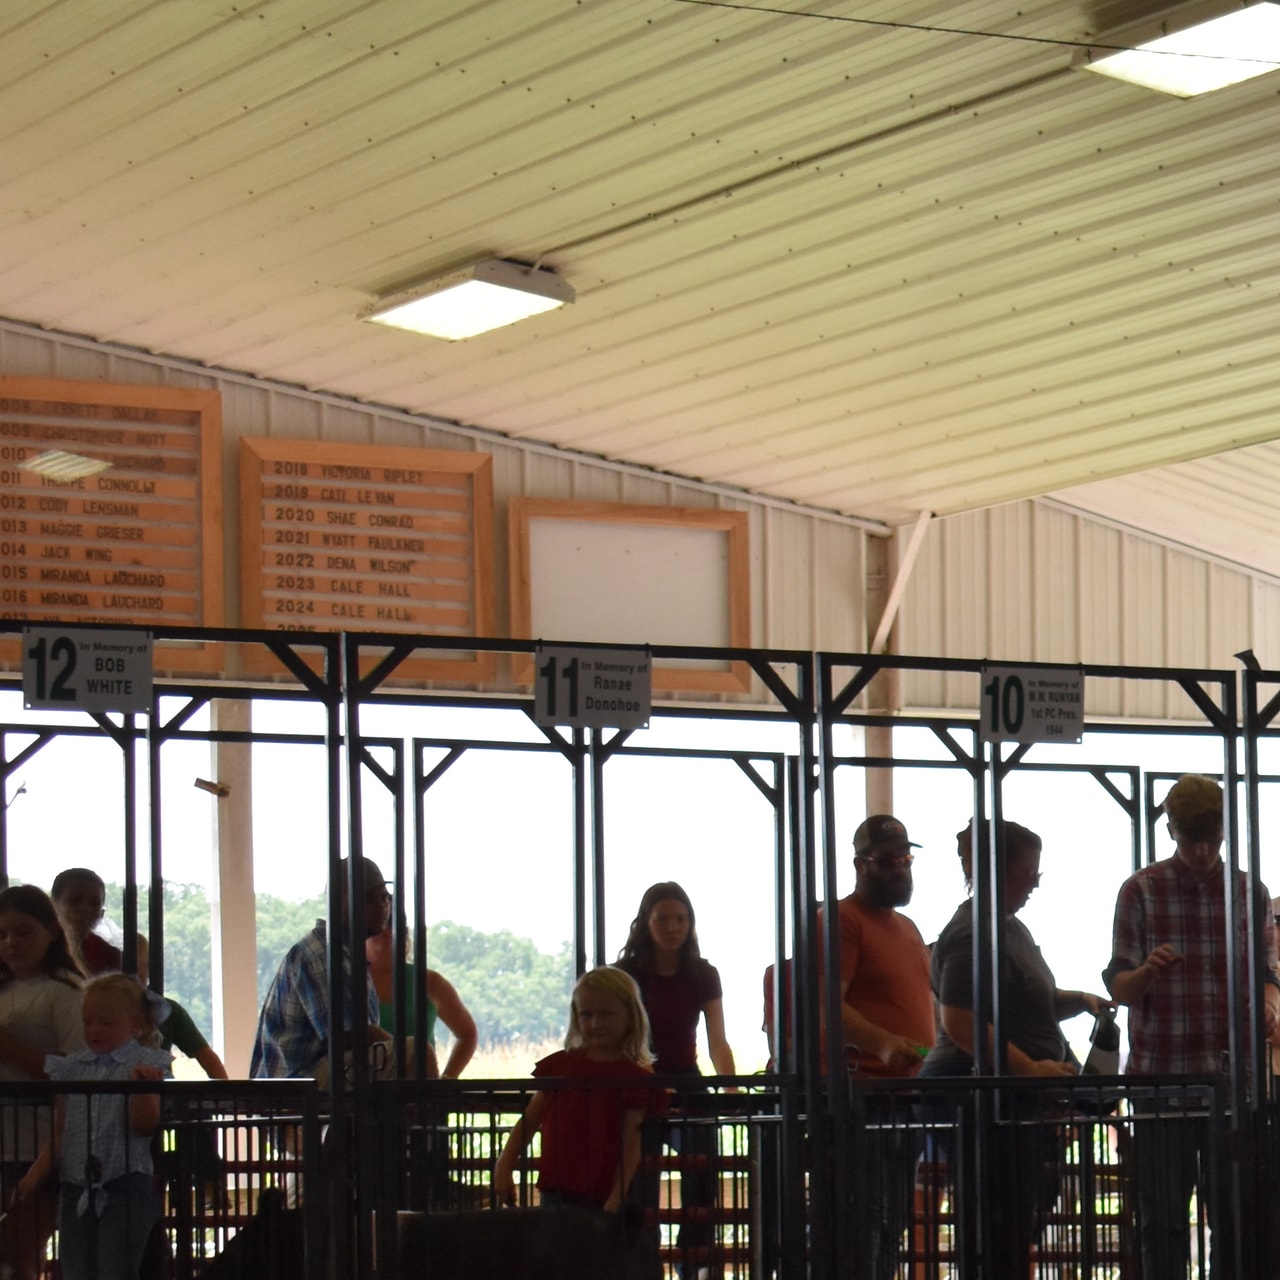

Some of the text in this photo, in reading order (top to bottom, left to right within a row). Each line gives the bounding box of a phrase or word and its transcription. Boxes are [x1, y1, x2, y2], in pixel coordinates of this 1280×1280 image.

[274, 460, 424, 484] 2018 VICTORIA RIPLEY
[275, 484, 309, 499] 2019
[82, 502, 139, 518] LENSMAN
[276, 507, 414, 530] 2020 SHAE CONRAD
[40, 522, 84, 537] MAGGIE
[275, 530, 425, 552] 2021 WYATT FAULKNER
[41, 546, 71, 561] JACK
[85, 549, 113, 563] WING
[276, 553, 412, 574] 2022 DENA WILSON
[40, 568, 92, 584] MIRANDA
[276, 576, 412, 598] 2023 CALE HALL
[40, 591, 89, 607] MIRANDA
[276, 600, 412, 622] 2024 CALE HALL
[93, 642, 134, 655] Memory
[137, 644, 148, 654] of
[28, 636, 78, 702] 12
[95, 657, 126, 673] BOB
[594, 662, 634, 675] Memory
[637, 664, 648, 673] of
[86, 679, 133, 696] WHITE
[540, 656, 579, 718] 11
[1038, 680, 1069, 690] Memory
[585, 696, 641, 712] Donohoe
[985, 675, 1025, 735] 10
